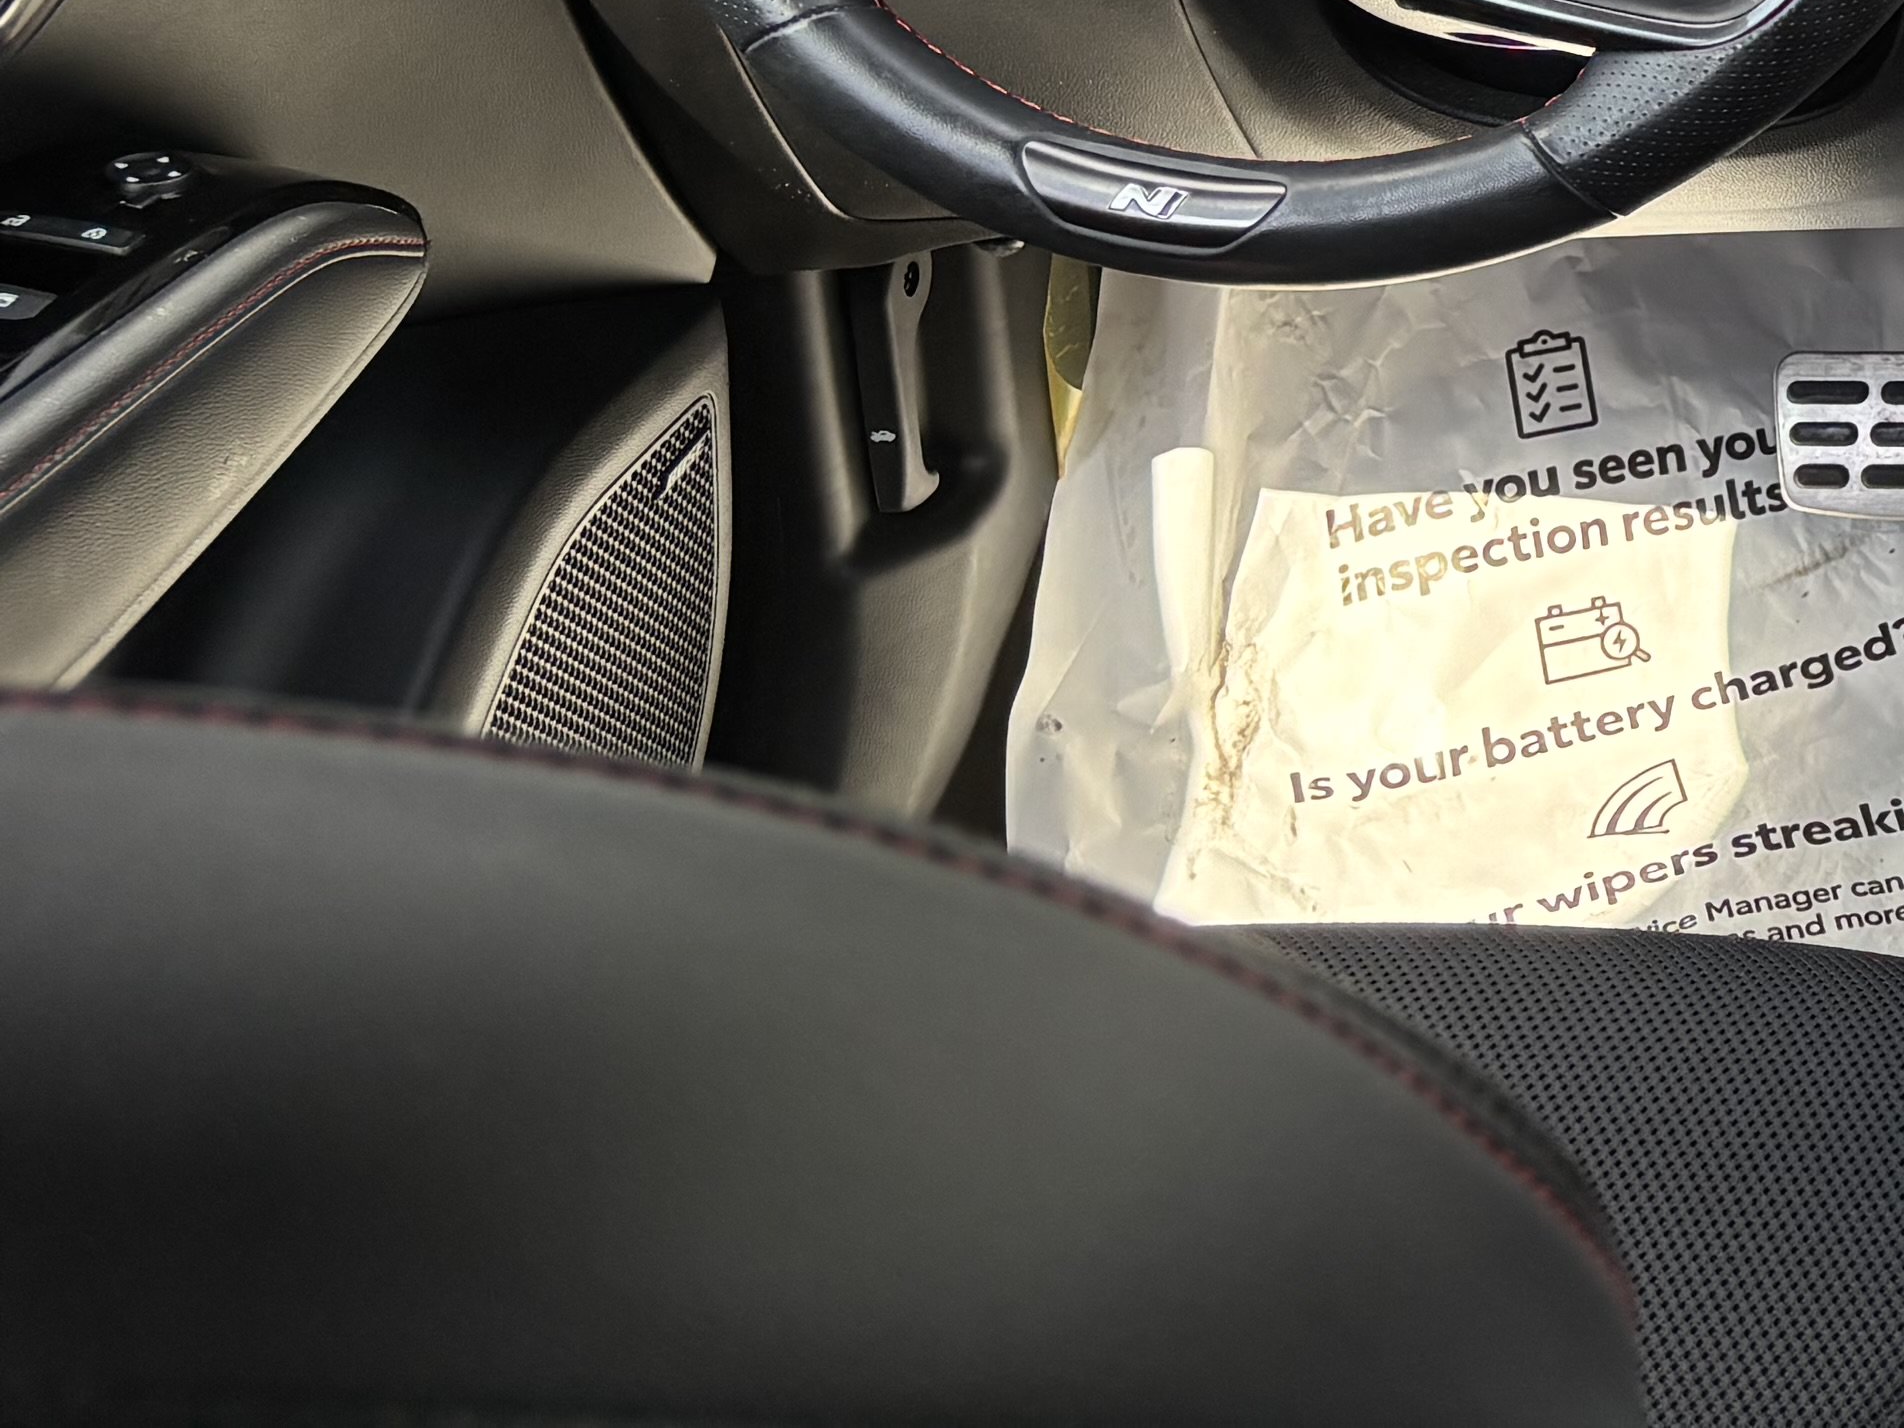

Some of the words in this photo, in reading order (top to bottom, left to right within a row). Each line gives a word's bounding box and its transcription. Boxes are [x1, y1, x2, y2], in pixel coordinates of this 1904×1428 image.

[1326, 488, 1454, 549] Have
[1462, 465, 1561, 524] you
[1572, 441, 1688, 491] seen
[1337, 516, 1611, 606] inspection
[1623, 478, 1788, 542] results
[1289, 772, 1335, 804] Is
[1346, 744, 1470, 803] your
[1481, 694, 1678, 769] battery
[1536, 840, 1719, 920] wipers
[1704, 881, 1844, 924] Manager
[1767, 913, 1826, 943] and
